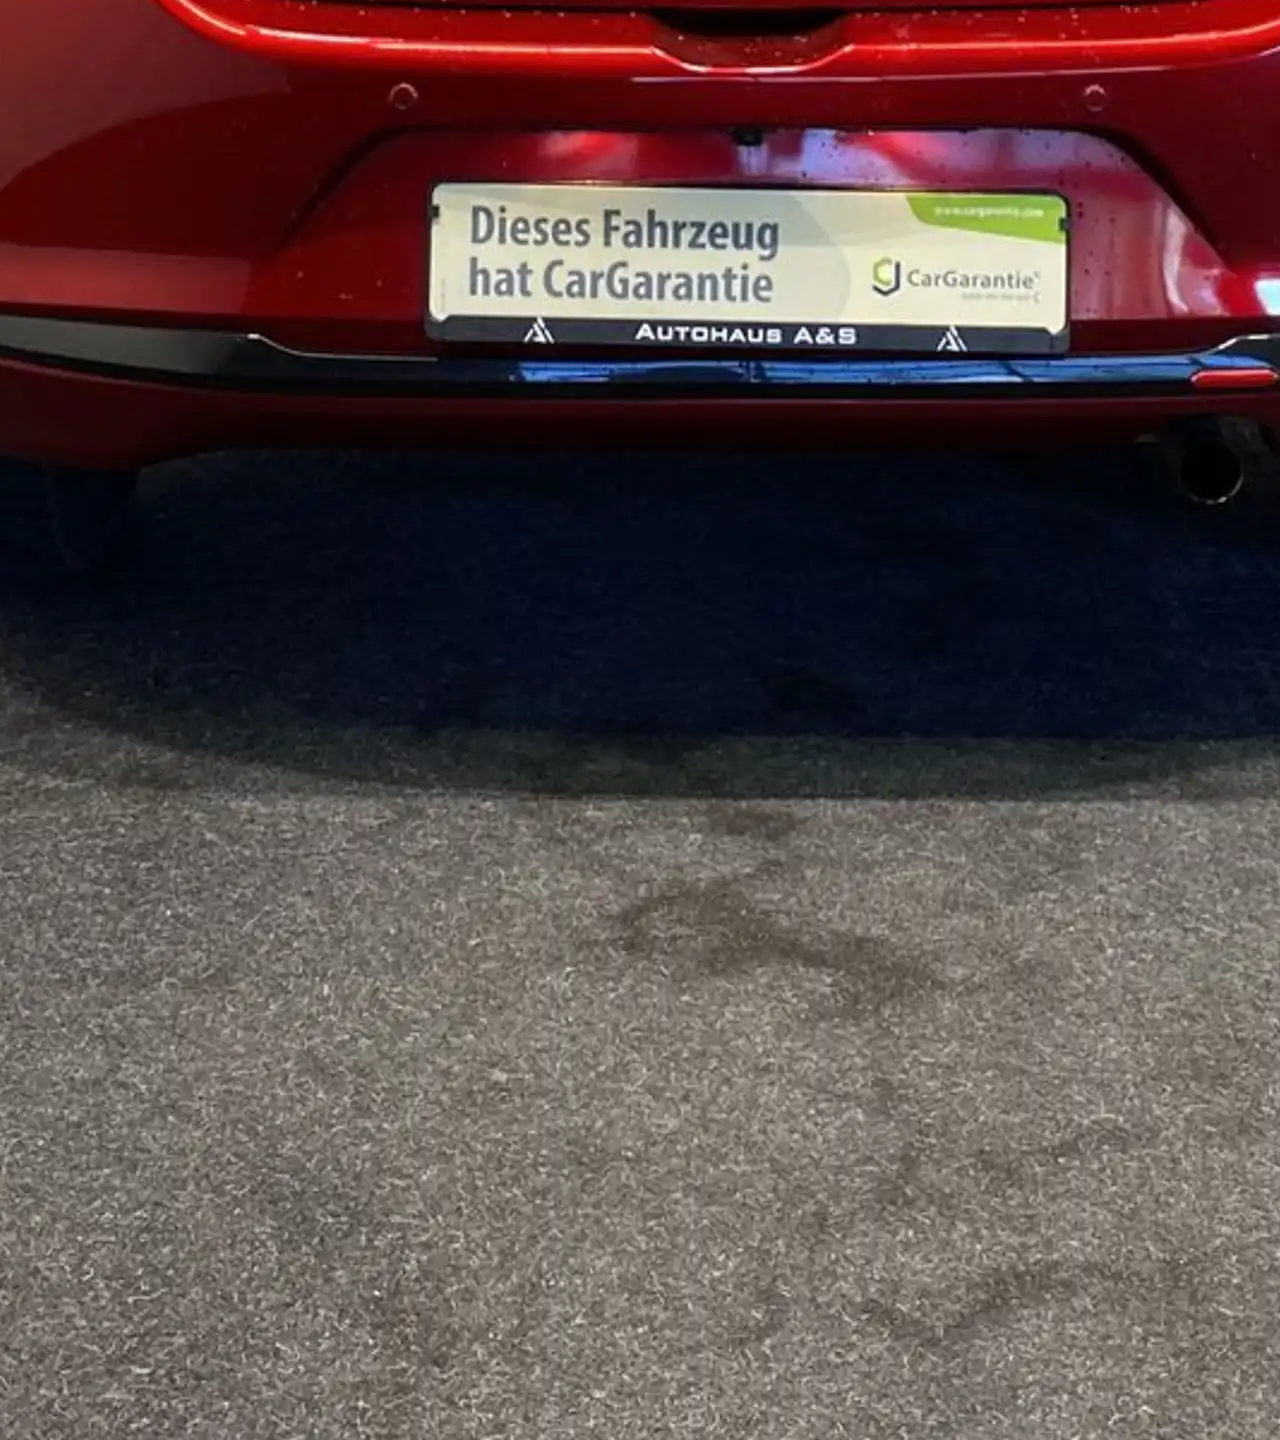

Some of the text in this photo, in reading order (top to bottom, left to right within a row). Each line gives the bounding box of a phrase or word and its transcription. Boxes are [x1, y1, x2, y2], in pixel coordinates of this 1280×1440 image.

[471, 205, 780, 261] Dieses Fahrzeug
[469, 257, 533, 297] hat
[543, 259, 774, 303] CarGarantie
[907, 268, 1034, 290] CarGarantie
[635, 323, 857, 345] AUTOHAUS A&S
